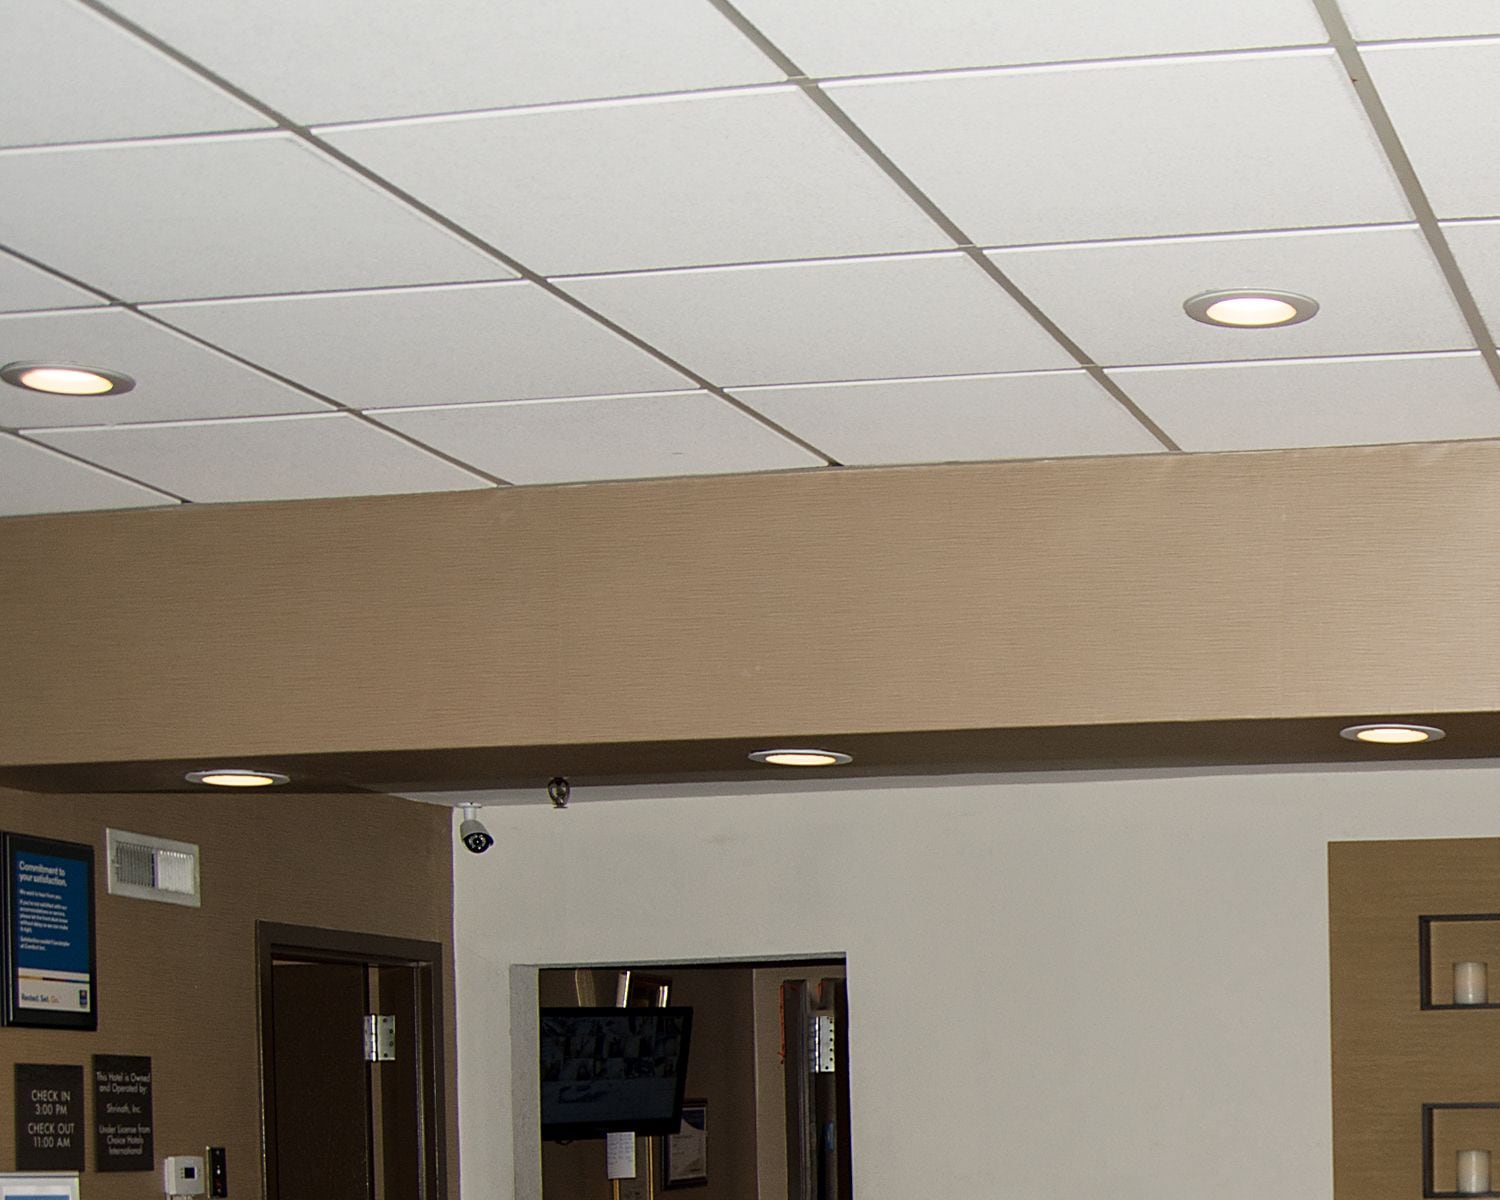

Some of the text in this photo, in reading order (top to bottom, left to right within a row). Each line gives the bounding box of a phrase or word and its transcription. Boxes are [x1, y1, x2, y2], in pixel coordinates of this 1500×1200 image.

[109, 1072, 123, 1082] Hotel
[112, 1083, 138, 1095] Operated
[32, 1090, 71, 1101] CHECK IN
[35, 1104, 68, 1116] 3:00 PM
[28, 1123, 75, 1135] CHECK OUT
[33, 1136, 71, 1148] 11:00 AM
